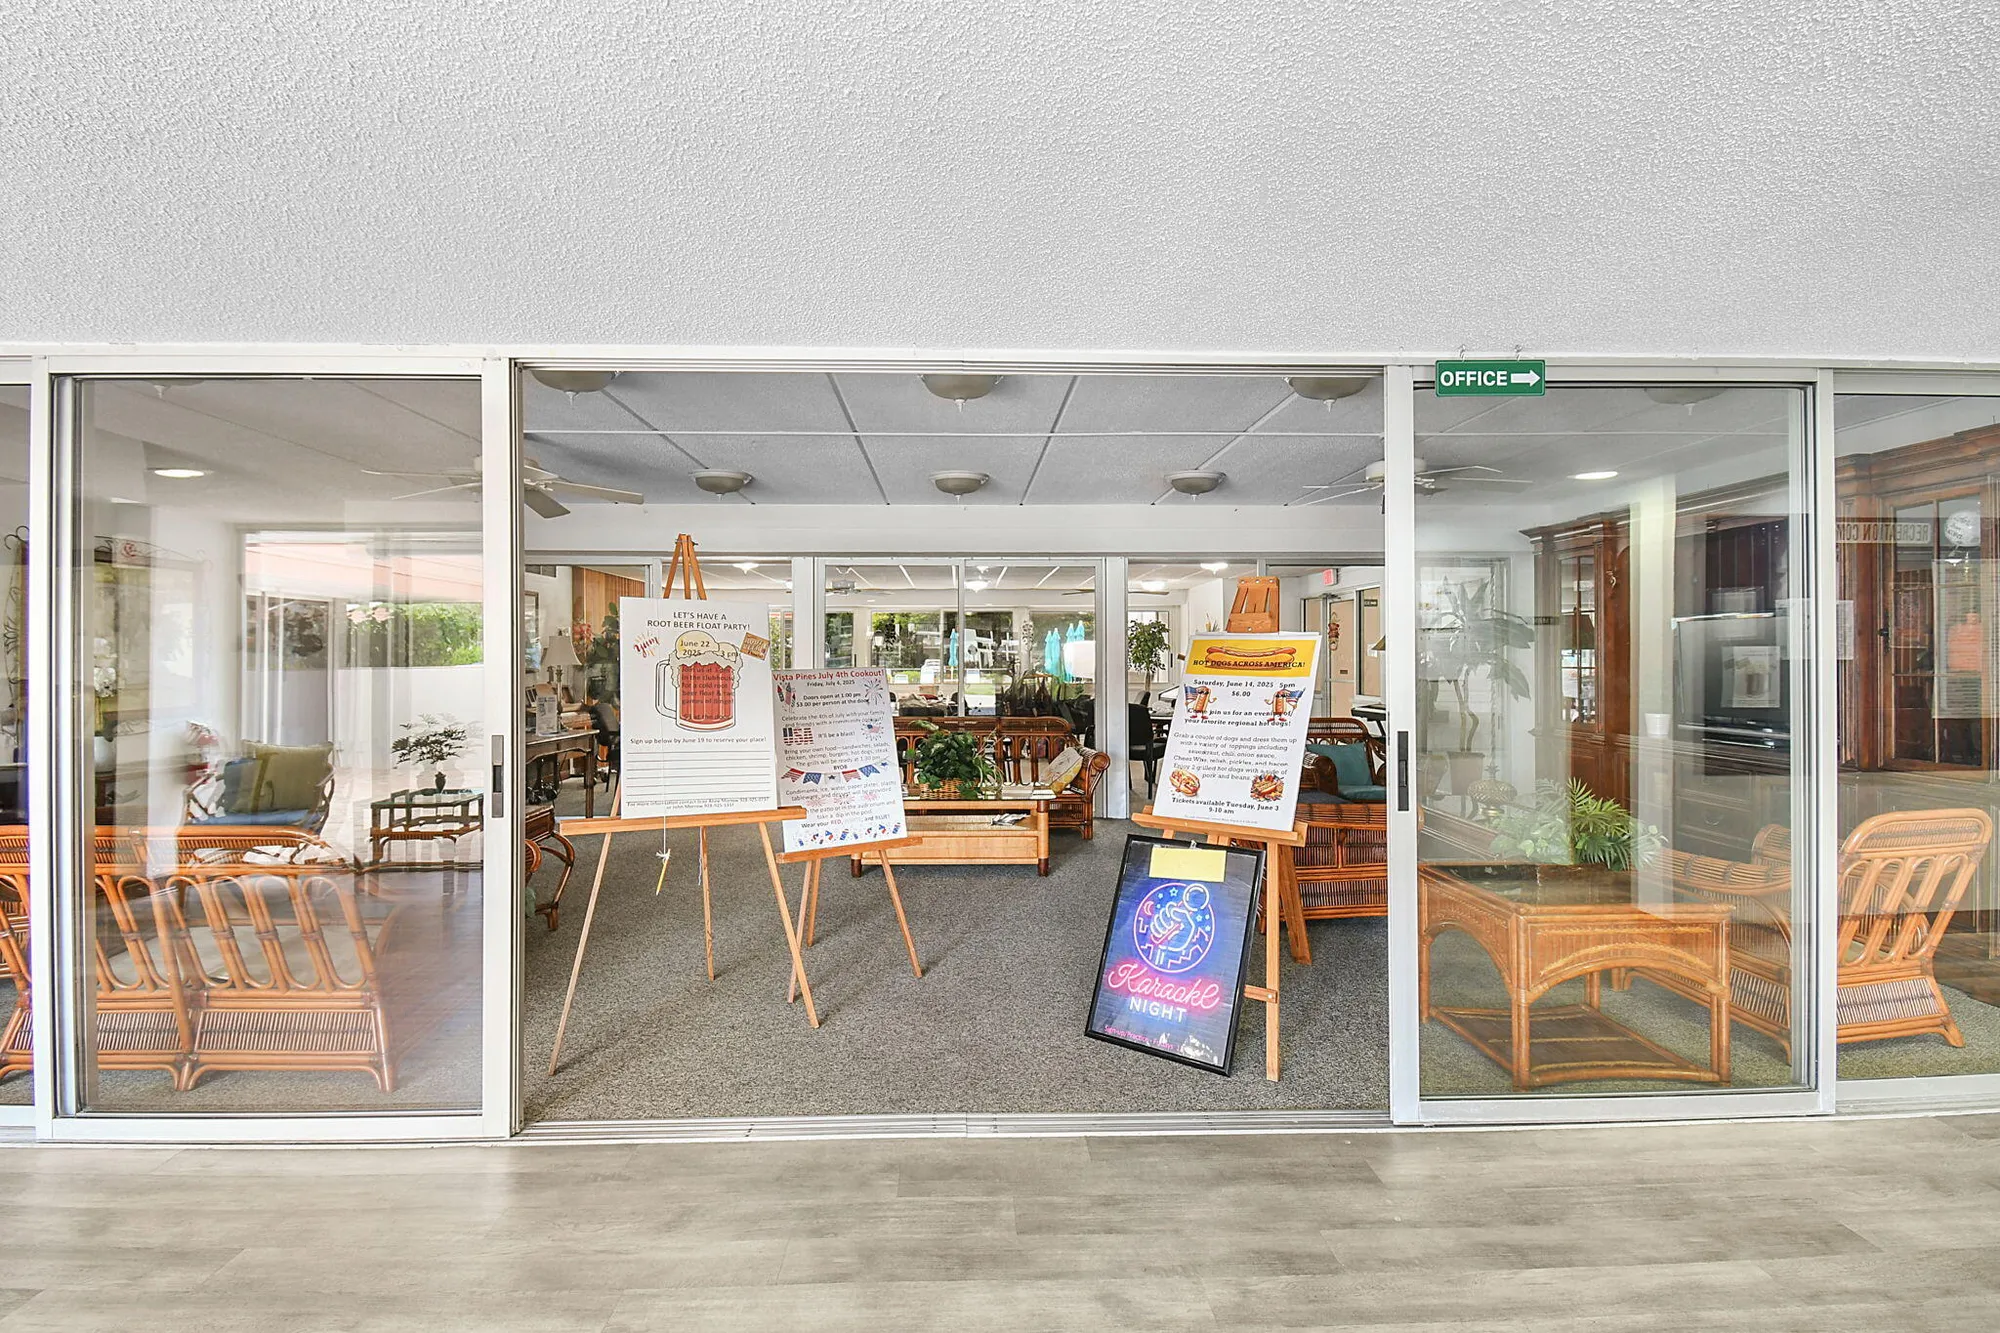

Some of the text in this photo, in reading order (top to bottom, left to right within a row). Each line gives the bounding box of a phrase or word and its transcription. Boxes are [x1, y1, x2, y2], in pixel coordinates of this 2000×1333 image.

[1440, 370, 1508, 386] OFFICE
[1226, 802, 1256, 810] Tuesday,
[1108, 963, 1220, 1009] Karaoke
[1129, 996, 1188, 1023] NIGHT
